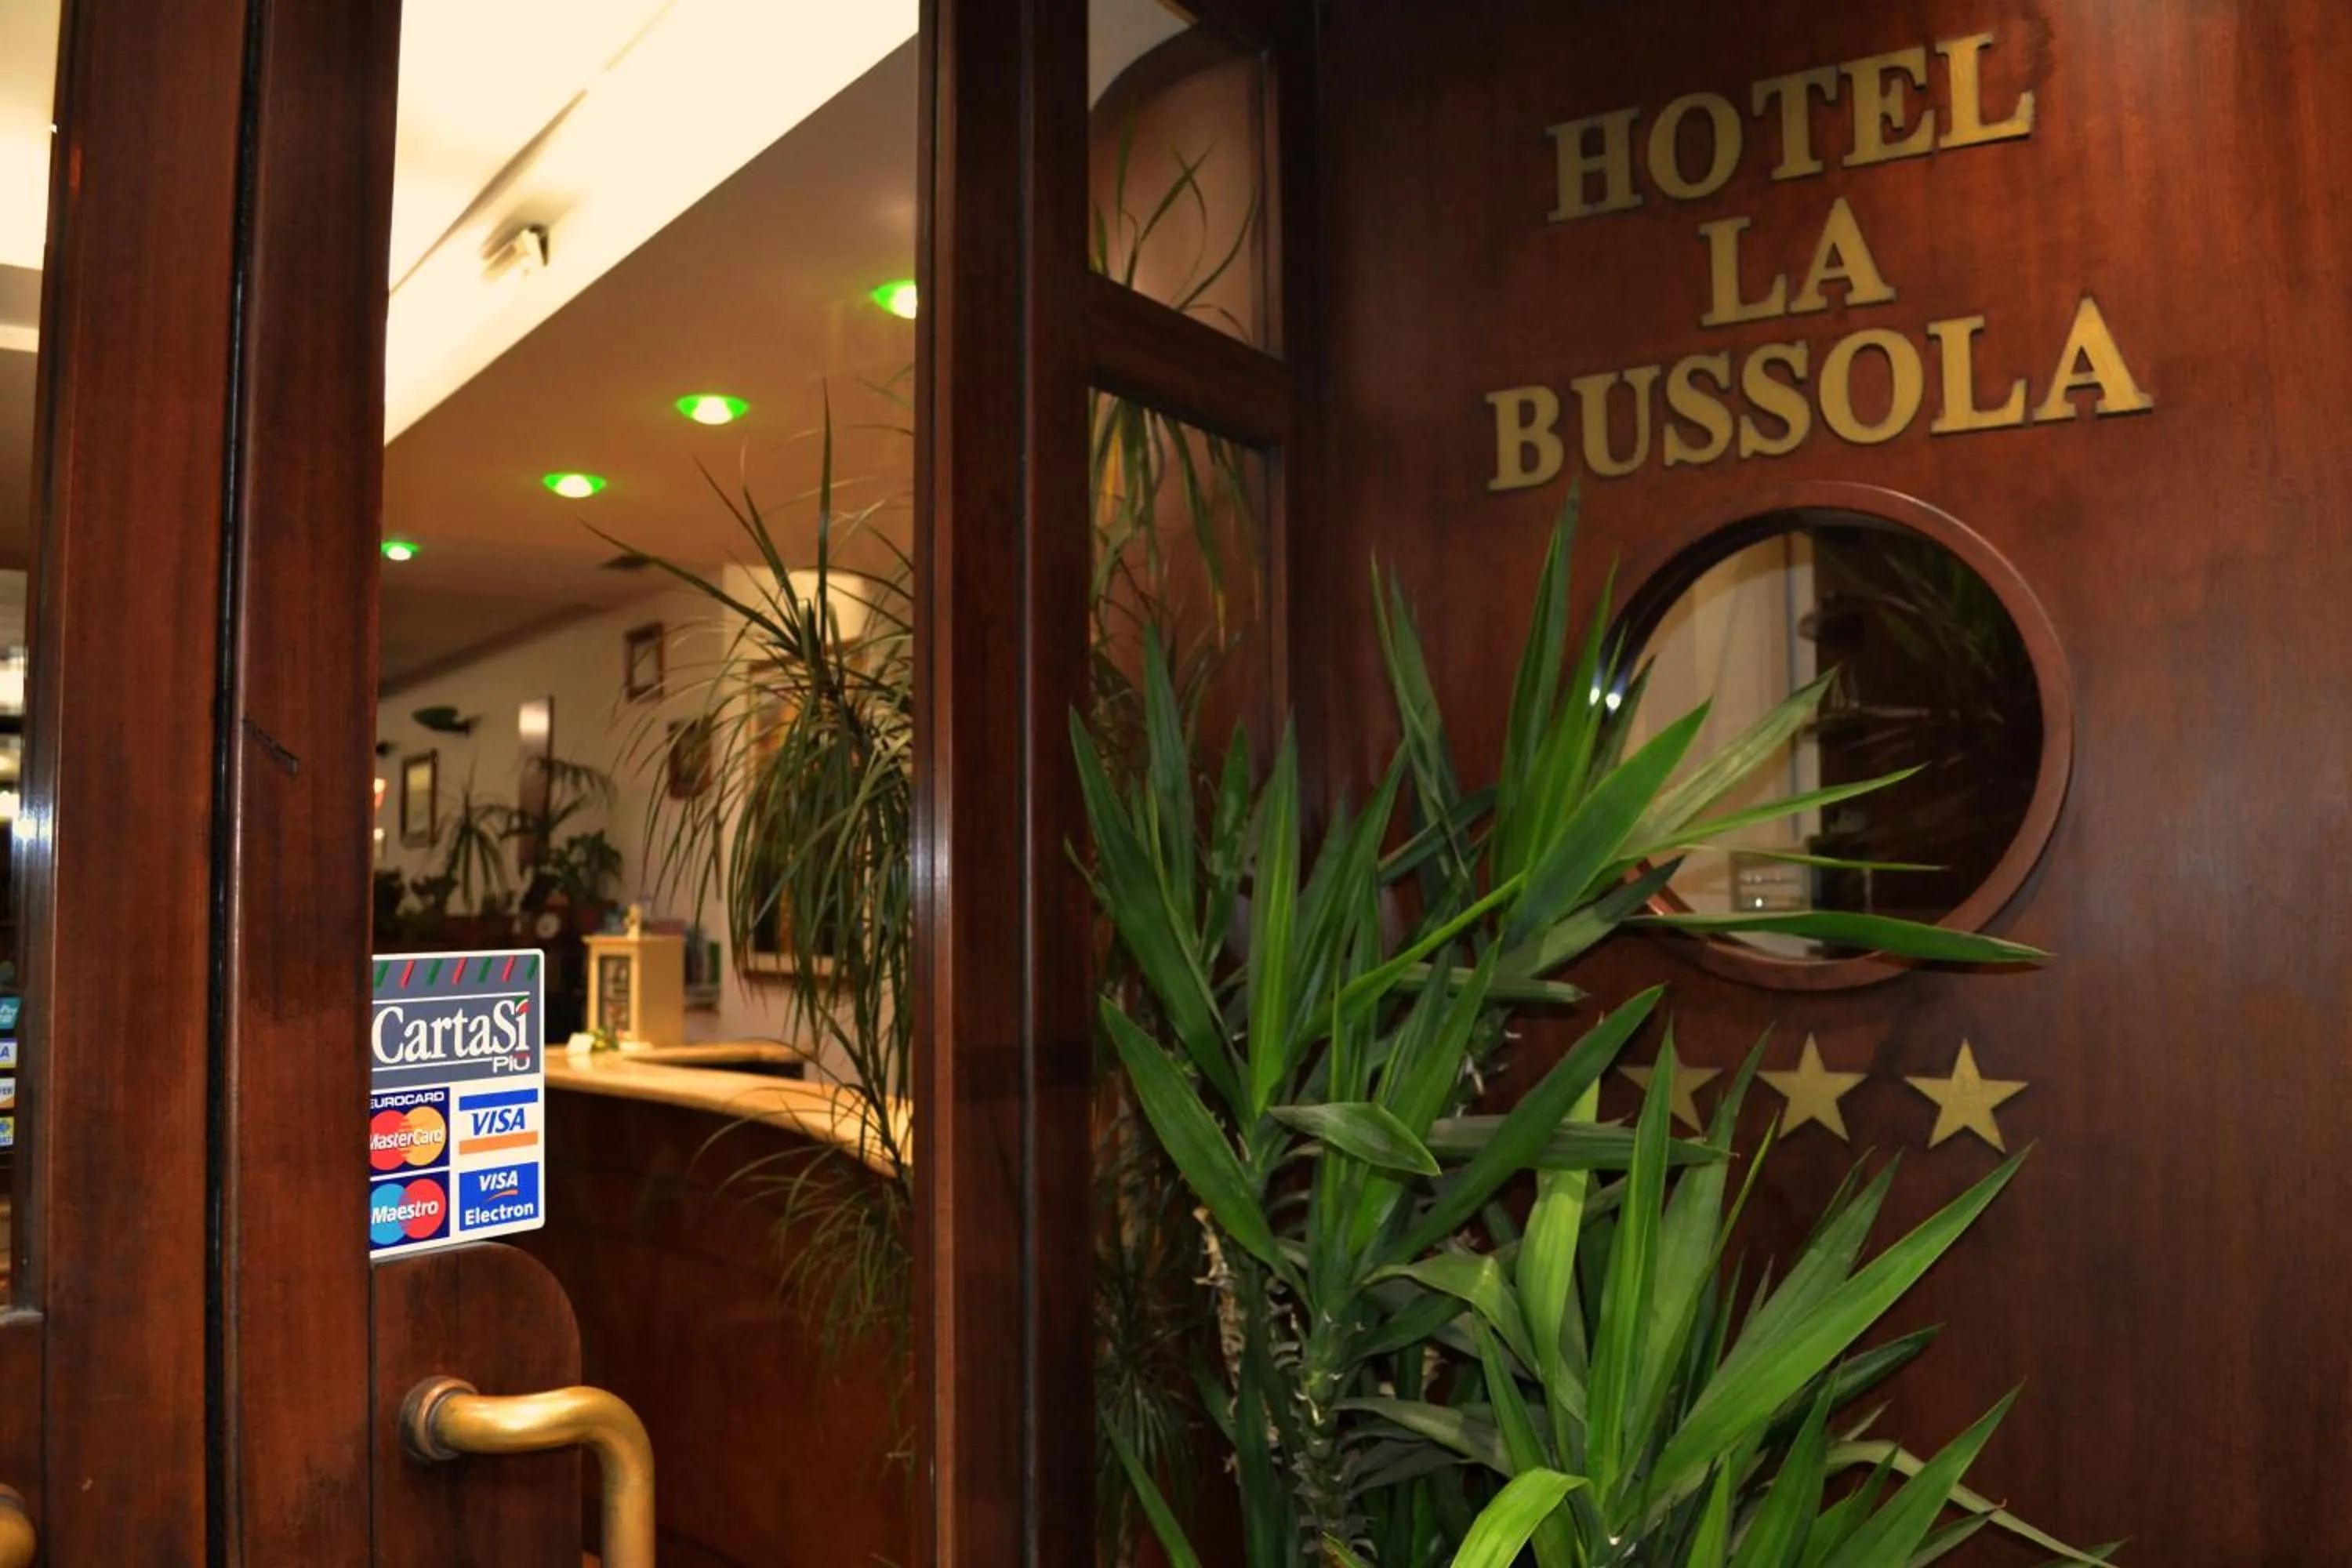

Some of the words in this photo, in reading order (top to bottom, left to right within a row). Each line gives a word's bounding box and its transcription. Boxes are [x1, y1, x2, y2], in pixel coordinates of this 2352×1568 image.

[1545, 32, 2034, 223] HOTEL
[1699, 198, 1896, 327] LA
[1486, 296, 2154, 491] BUSSOLA
[472, 1107, 525, 1136] VISA
[479, 1170, 519, 1192] VISA
[372, 1200, 439, 1225] Maestro
[465, 1202, 534, 1225] Electron
